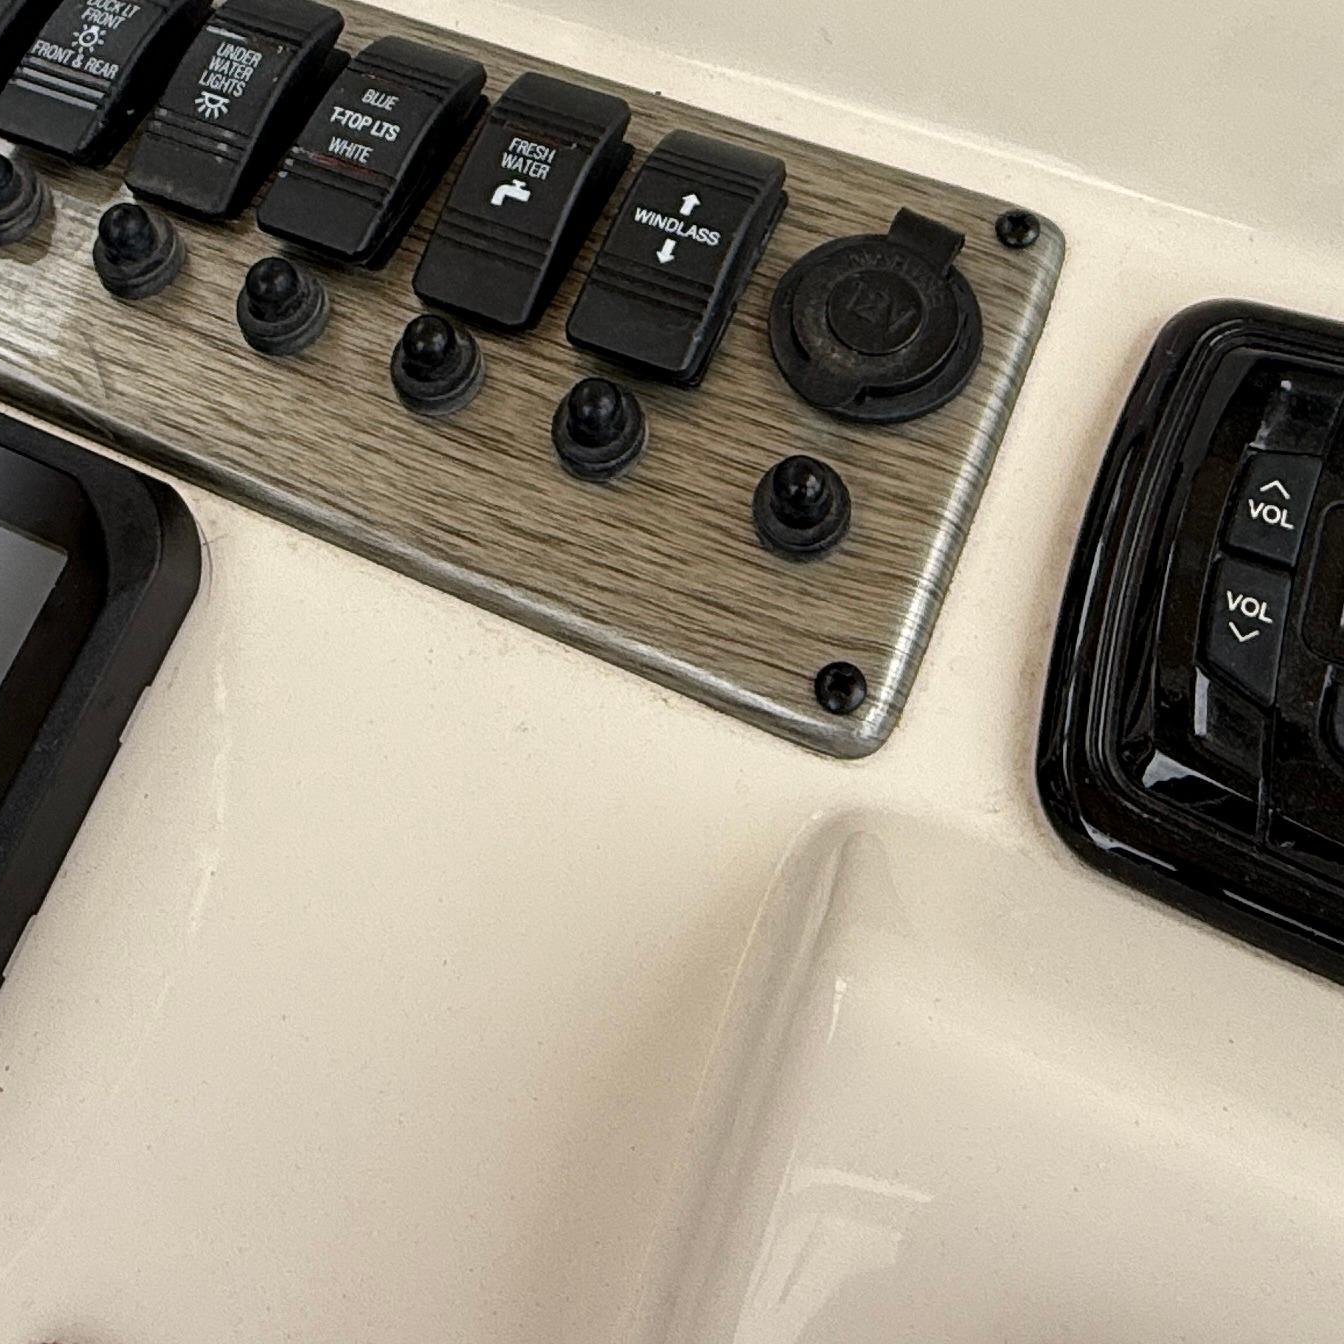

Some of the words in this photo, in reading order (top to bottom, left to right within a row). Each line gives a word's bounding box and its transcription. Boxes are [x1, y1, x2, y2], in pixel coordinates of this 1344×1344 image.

[81, 8, 129, 30] FRONT
[123, 2, 141, 19] LT
[30, 40, 76, 66] FRONT
[71, 55, 84, 68] &
[83, 59, 119, 80] REAR
[216, 41, 262, 67] UNDER
[209, 56, 254, 81] WATER
[198, 70, 247, 97] LIGHTS
[361, 88, 399, 112] BLUE
[330, 106, 373, 131] T-TOP
[370, 119, 400, 143] LTS
[328, 136, 373, 164] WHITE
[509, 137, 556, 164] FRESH
[501, 152, 551, 180] WATER
[634, 206, 720, 247] WINDLASS
[1248, 499, 1295, 530] VOL
[1225, 590, 1274, 625] VOL
